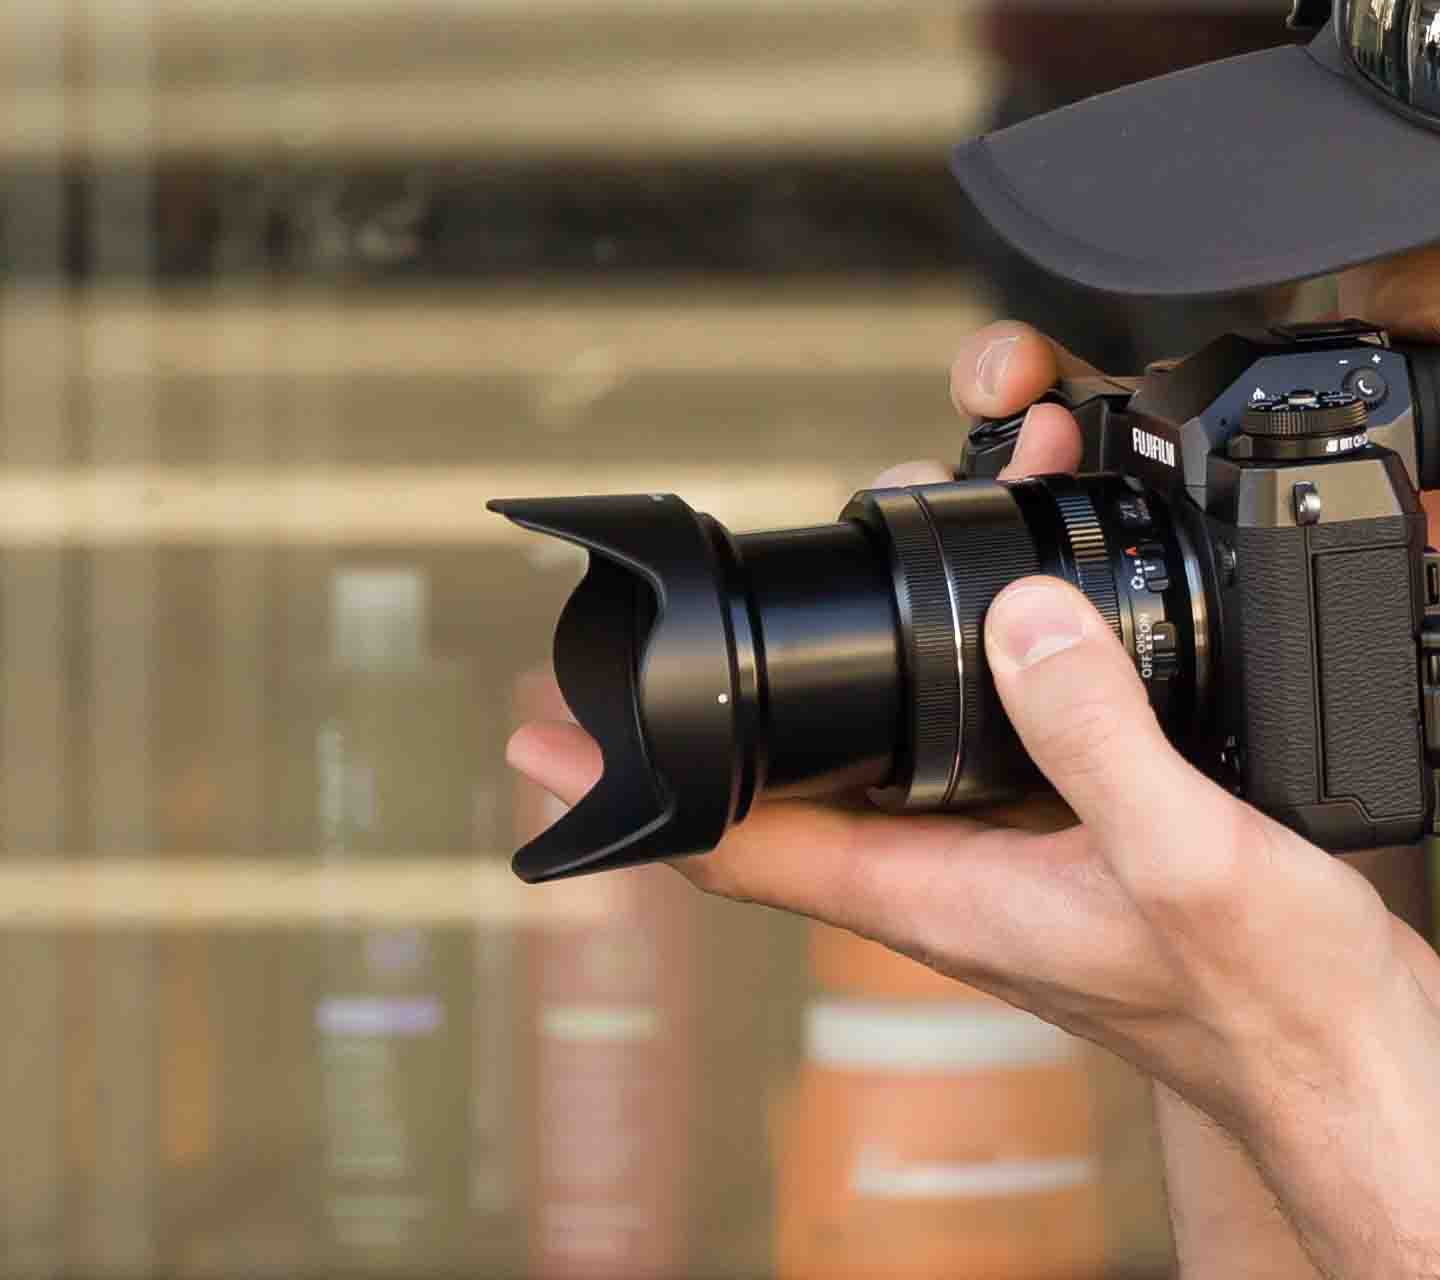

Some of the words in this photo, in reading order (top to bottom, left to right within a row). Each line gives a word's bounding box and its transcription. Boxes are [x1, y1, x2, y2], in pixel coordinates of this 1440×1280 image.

[1132, 427, 1175, 468] FUJIFILM
[1139, 613, 1151, 633] ON
[1136, 633, 1146, 654] OIS
[1141, 655, 1153, 678] OFF
